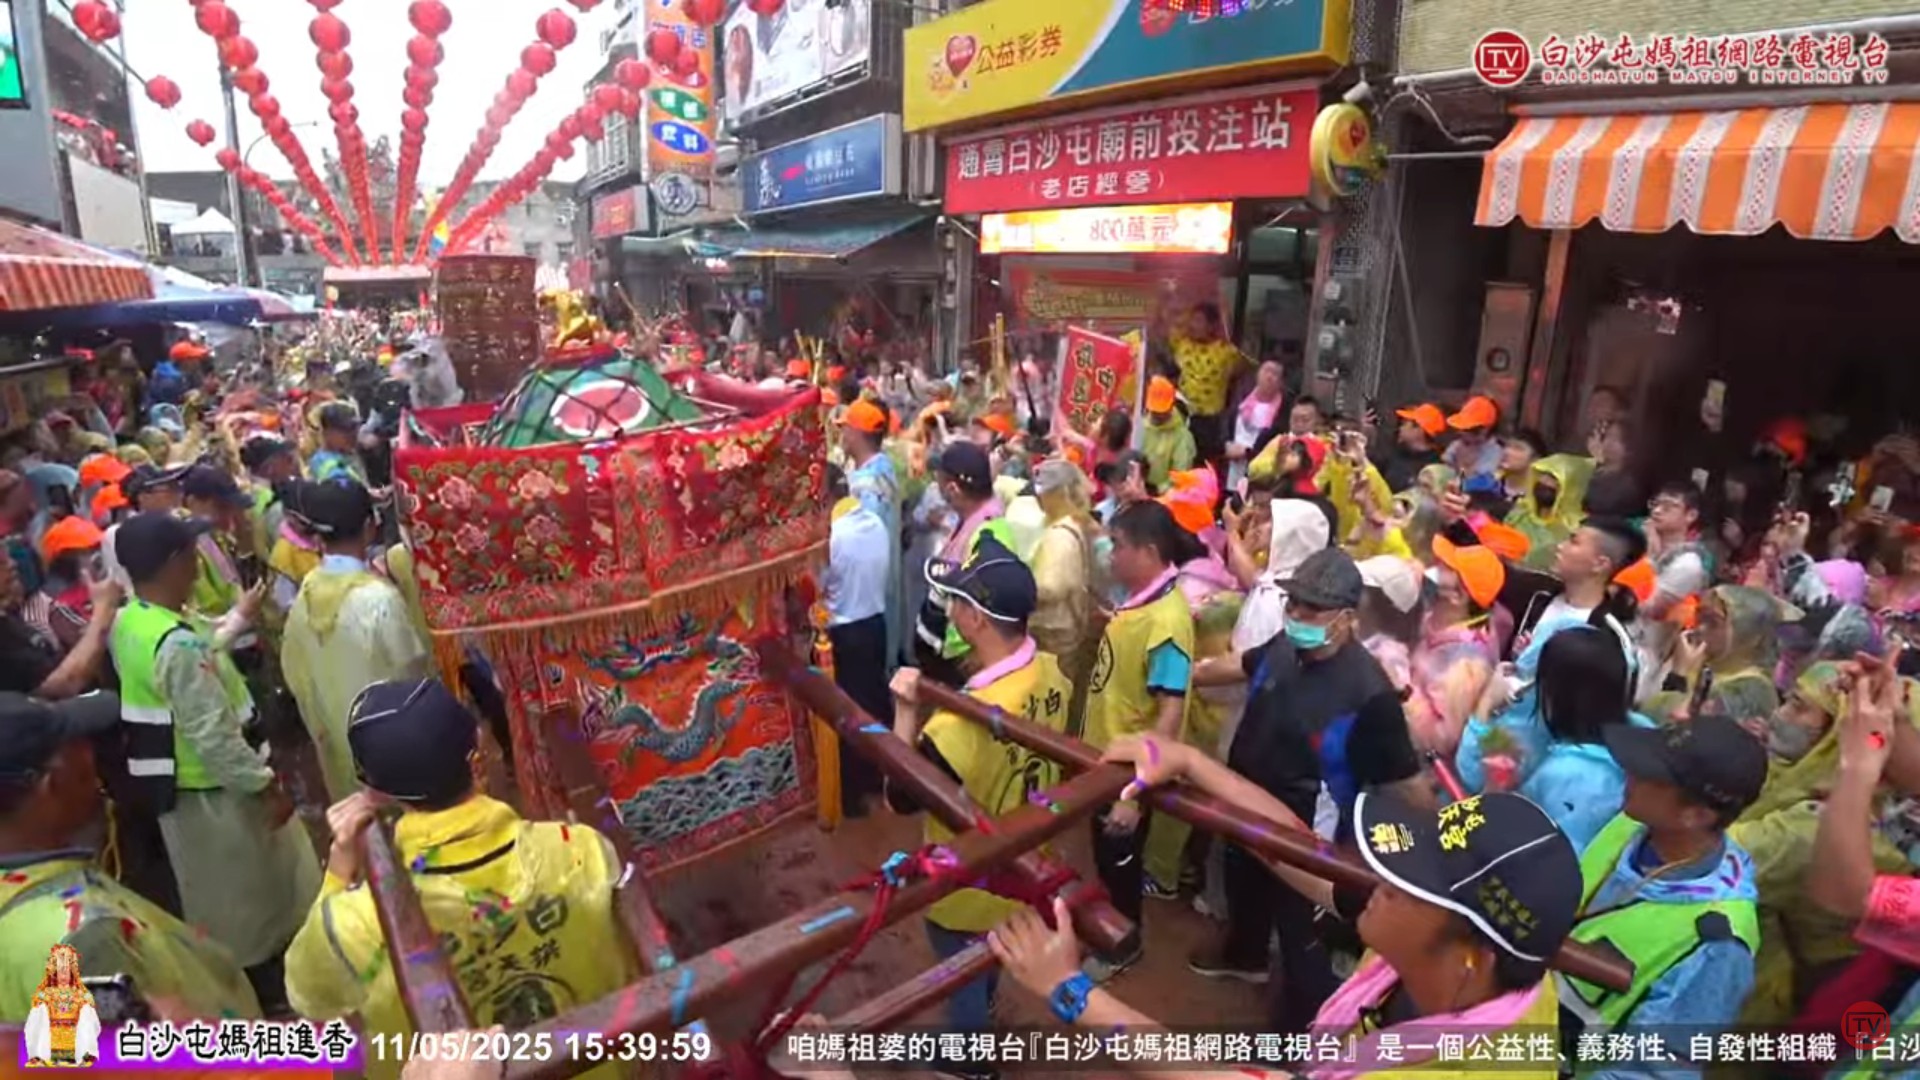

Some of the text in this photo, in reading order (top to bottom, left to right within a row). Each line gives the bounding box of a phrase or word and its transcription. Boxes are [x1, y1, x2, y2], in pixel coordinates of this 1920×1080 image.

[976, 25, 1062, 74] 公益彩券
[957, 98, 1292, 180] 通霄白沙屯廟前投注站
